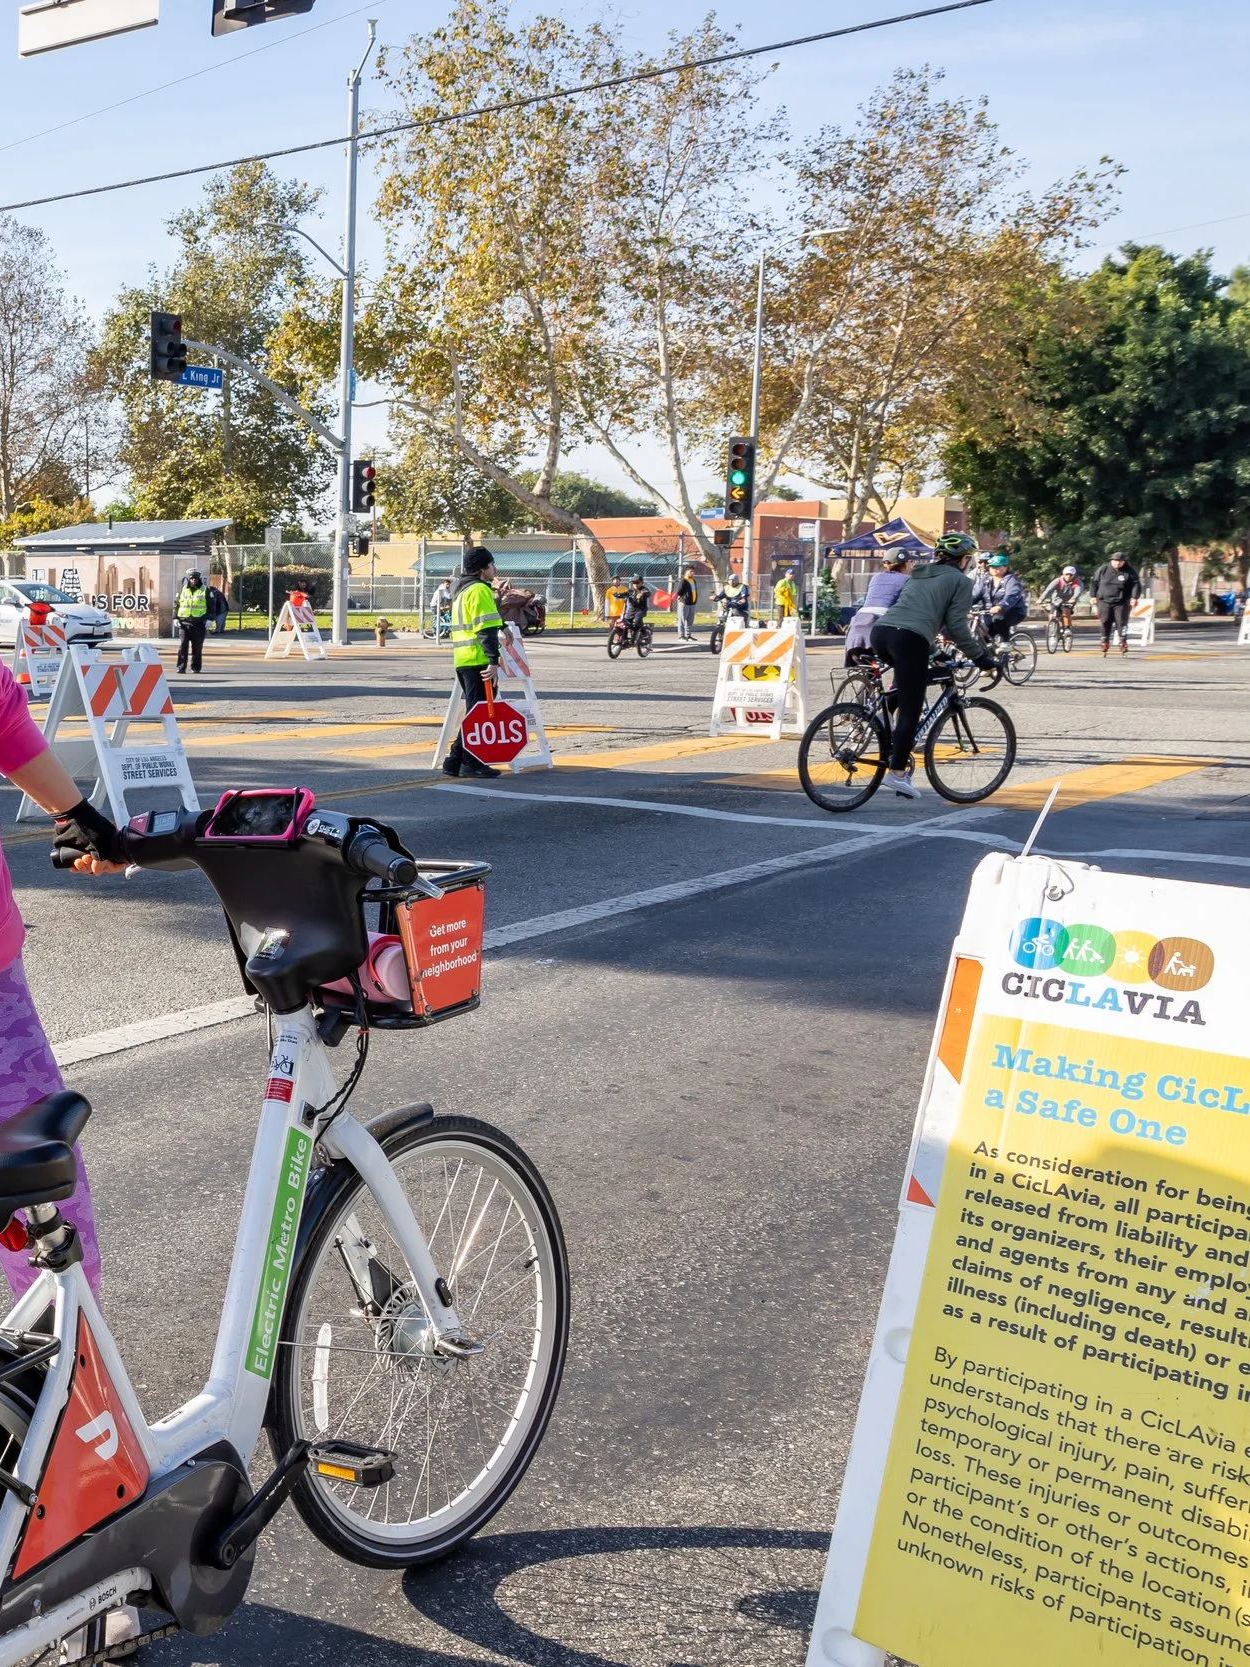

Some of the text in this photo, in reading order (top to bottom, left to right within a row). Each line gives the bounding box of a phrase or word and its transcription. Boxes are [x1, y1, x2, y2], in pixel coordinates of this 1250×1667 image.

[190, 370, 208, 385] King
[211, 372, 220, 384] Jr
[112, 594, 150, 611] FOR
[142, 761, 158, 769] PUBLIC
[466, 719, 523, 746] STOP
[123, 768, 178, 780] STREET SERVICES
[422, 950, 477, 978] neighborhood
[430, 919, 466, 937] Get more
[430, 937, 468, 957] from your
[1001, 972, 1206, 1026] CICLAVIA
[984, 1088, 1187, 1147] a Safe One
[991, 1044, 1250, 1115] Making CicL
[969, 1161, 1250, 1243] in a CicLAvia, all participa
[973, 1141, 998, 1159] As
[1006, 1152, 1148, 1193] consideration
[1155, 1179, 1190, 1201] for
[254, 1137, 307, 1373] Electric Metro Bike
[960, 1207, 1250, 1301] its organizers, their emplo
[964, 1188, 1250, 1268] released from liability and
[951, 1255, 1013, 1284] claims
[1019, 1274, 1044, 1291] of
[1047, 1283, 1172, 1329] negligence,
[955, 1235, 1250, 1322] and agents from any and a
[942, 1304, 964, 1319] as
[969, 1311, 982, 1325] a
[988, 1316, 1048, 1344] result
[1053, 1334, 1079, 1352] of
[1082, 1343, 1229, 1401] participating
[947, 1276, 1007, 1307] illness
[1014, 1295, 1117, 1342] (including
[1124, 1326, 1197, 1363] death)
[1204, 1352, 1231, 1369] or
[929, 1373, 1050, 1421] understands
[1056, 1410, 1098, 1437] that
[1104, 1425, 1161, 1456] there
[1166, 1447, 1204, 1470] are
[934, 1345, 958, 1370] By
[962, 1359, 1088, 1411] participating
[1095, 1395, 1113, 1415] in
[1120, 1408, 1133, 1421] a
[1140, 1409, 1236, 1453] CicLAvia
[920, 1417, 1023, 1467] temporary
[1028, 1457, 1051, 1472] or
[1055, 1465, 1174, 1516] permanent
[923, 1396, 1250, 1514] psychological injury, pain, suffer
[915, 1438, 1250, 1569] loss. These injuries or outcomes
[98, 1585, 117, 1604] BOSCH
[902, 1510, 1028, 1574] Nonetheless,
[1034, 1564, 1162, 1622] participants
[906, 1491, 928, 1507] or
[932, 1497, 964, 1521] the
[970, 1514, 1063, 1558] condition
[1070, 1550, 1095, 1568] of
[1098, 1558, 1134, 1584] the
[1141, 1570, 1231, 1620] location
[1036, 1512, 1059, 1528] or
[1145, 1551, 1231, 1594] actions,
[1241, 1579, 1250, 1599] i
[897, 1538, 984, 1582] unknown
[990, 1572, 1035, 1601] risks
[1042, 1594, 1066, 1611] of
[1069, 1604, 1209, 1667] participation
